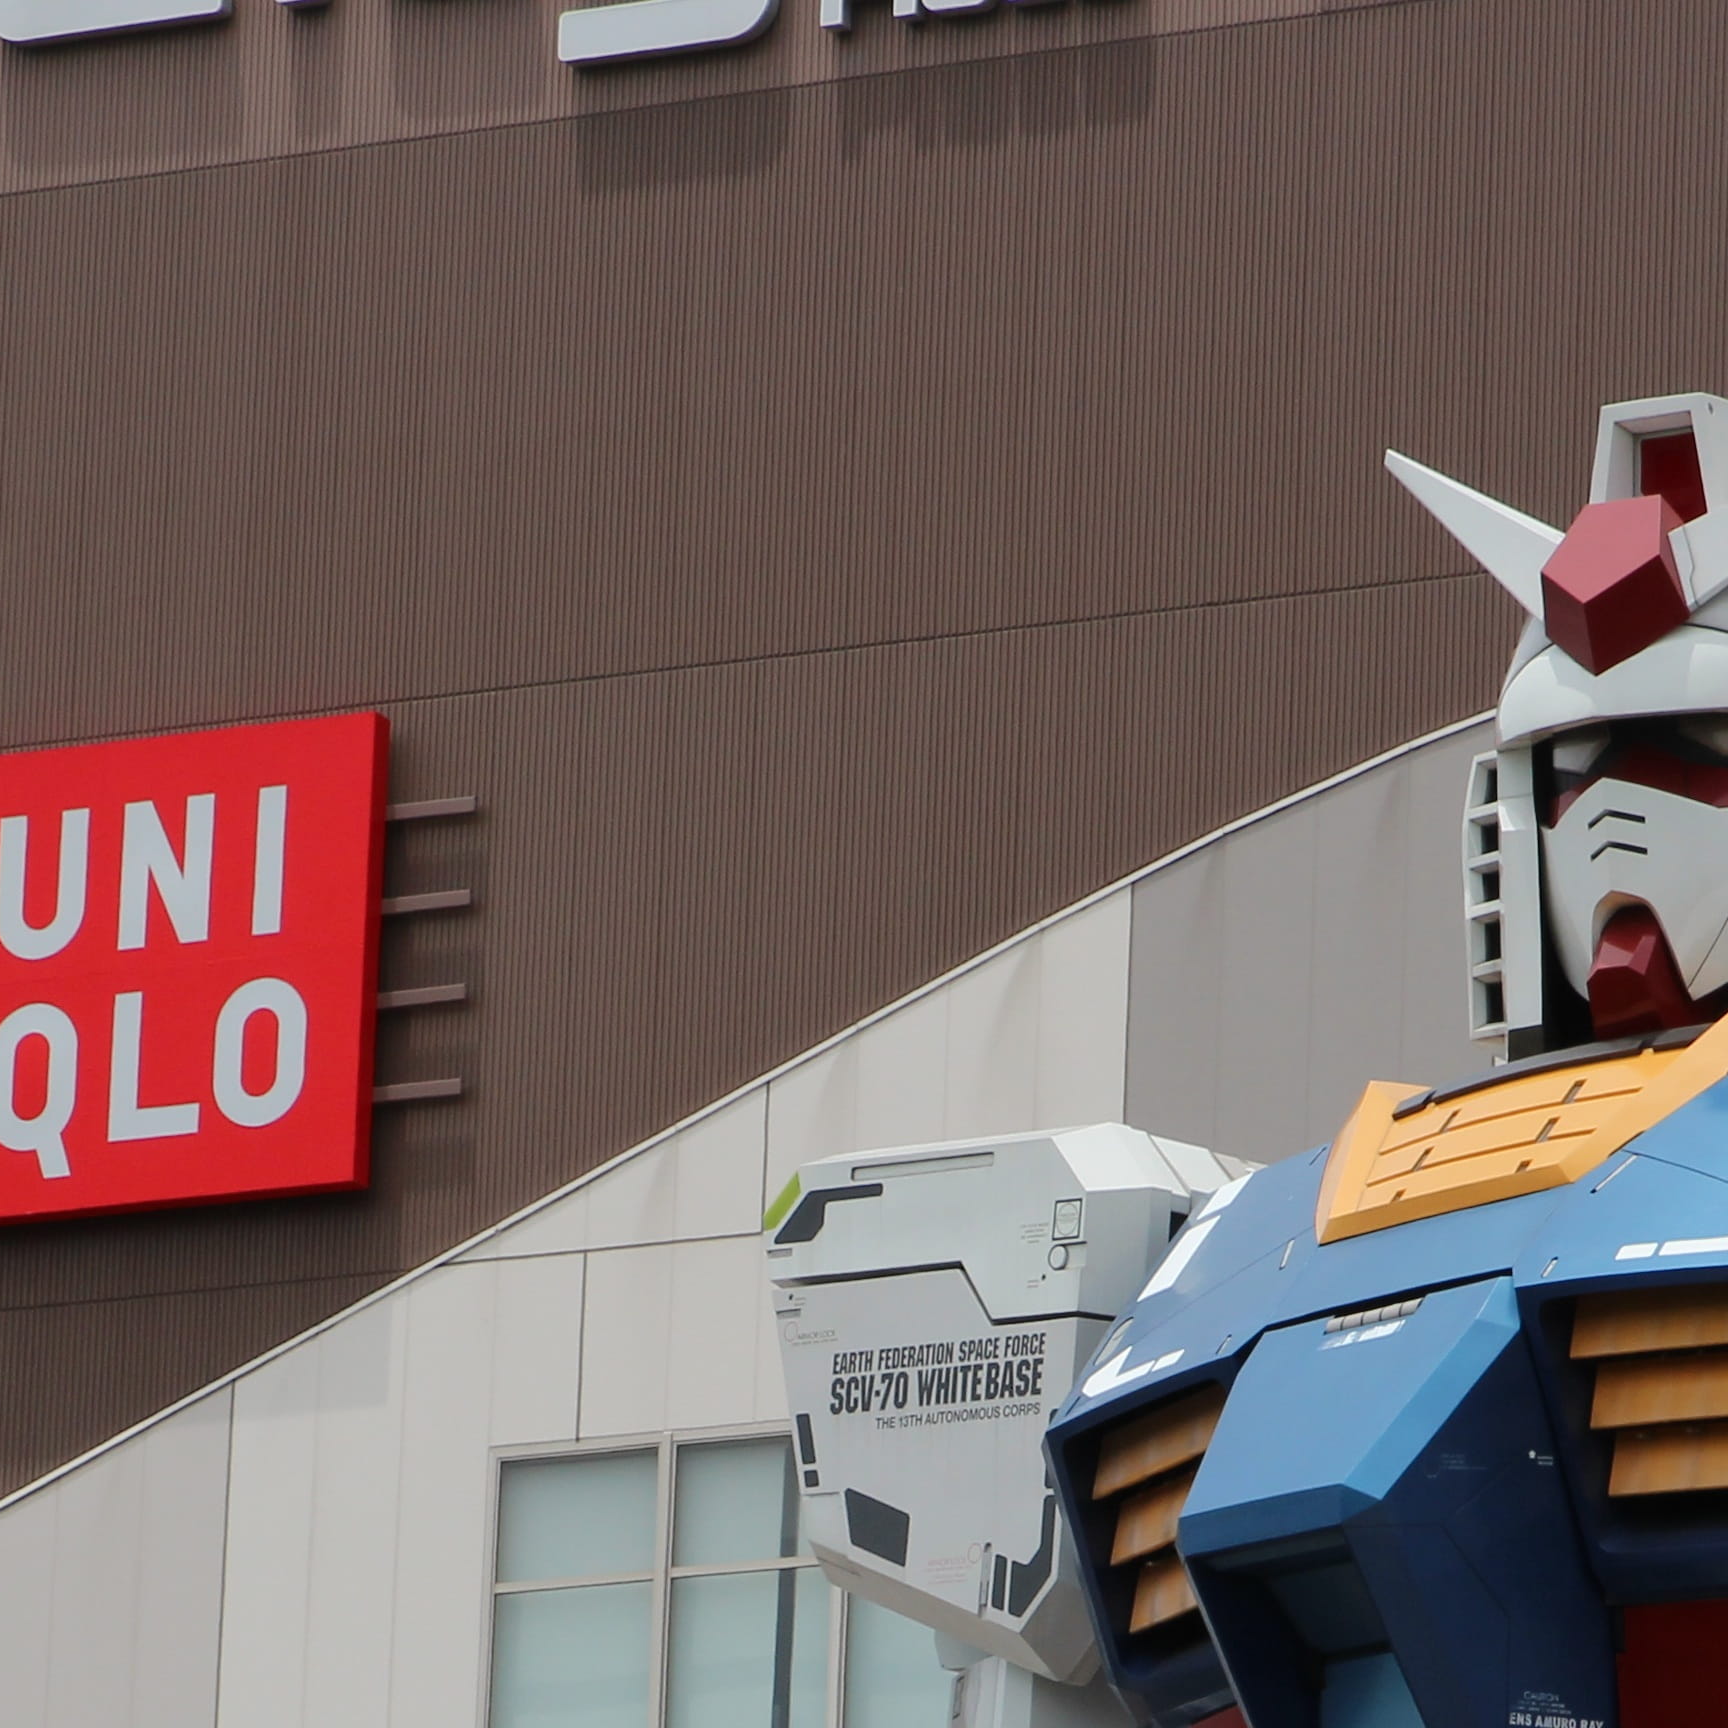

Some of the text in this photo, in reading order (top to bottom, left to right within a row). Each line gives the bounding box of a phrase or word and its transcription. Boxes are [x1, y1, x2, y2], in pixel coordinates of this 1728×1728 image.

[832, 1332, 1047, 1375] EARTH FEDERATION SPACE FORCE
[830, 1371, 909, 1415] SCV-70
[876, 1402, 1041, 1430] THE 13TH AUTONOMOUS CORPS
[1509, 1712, 1532, 1726] ENS
